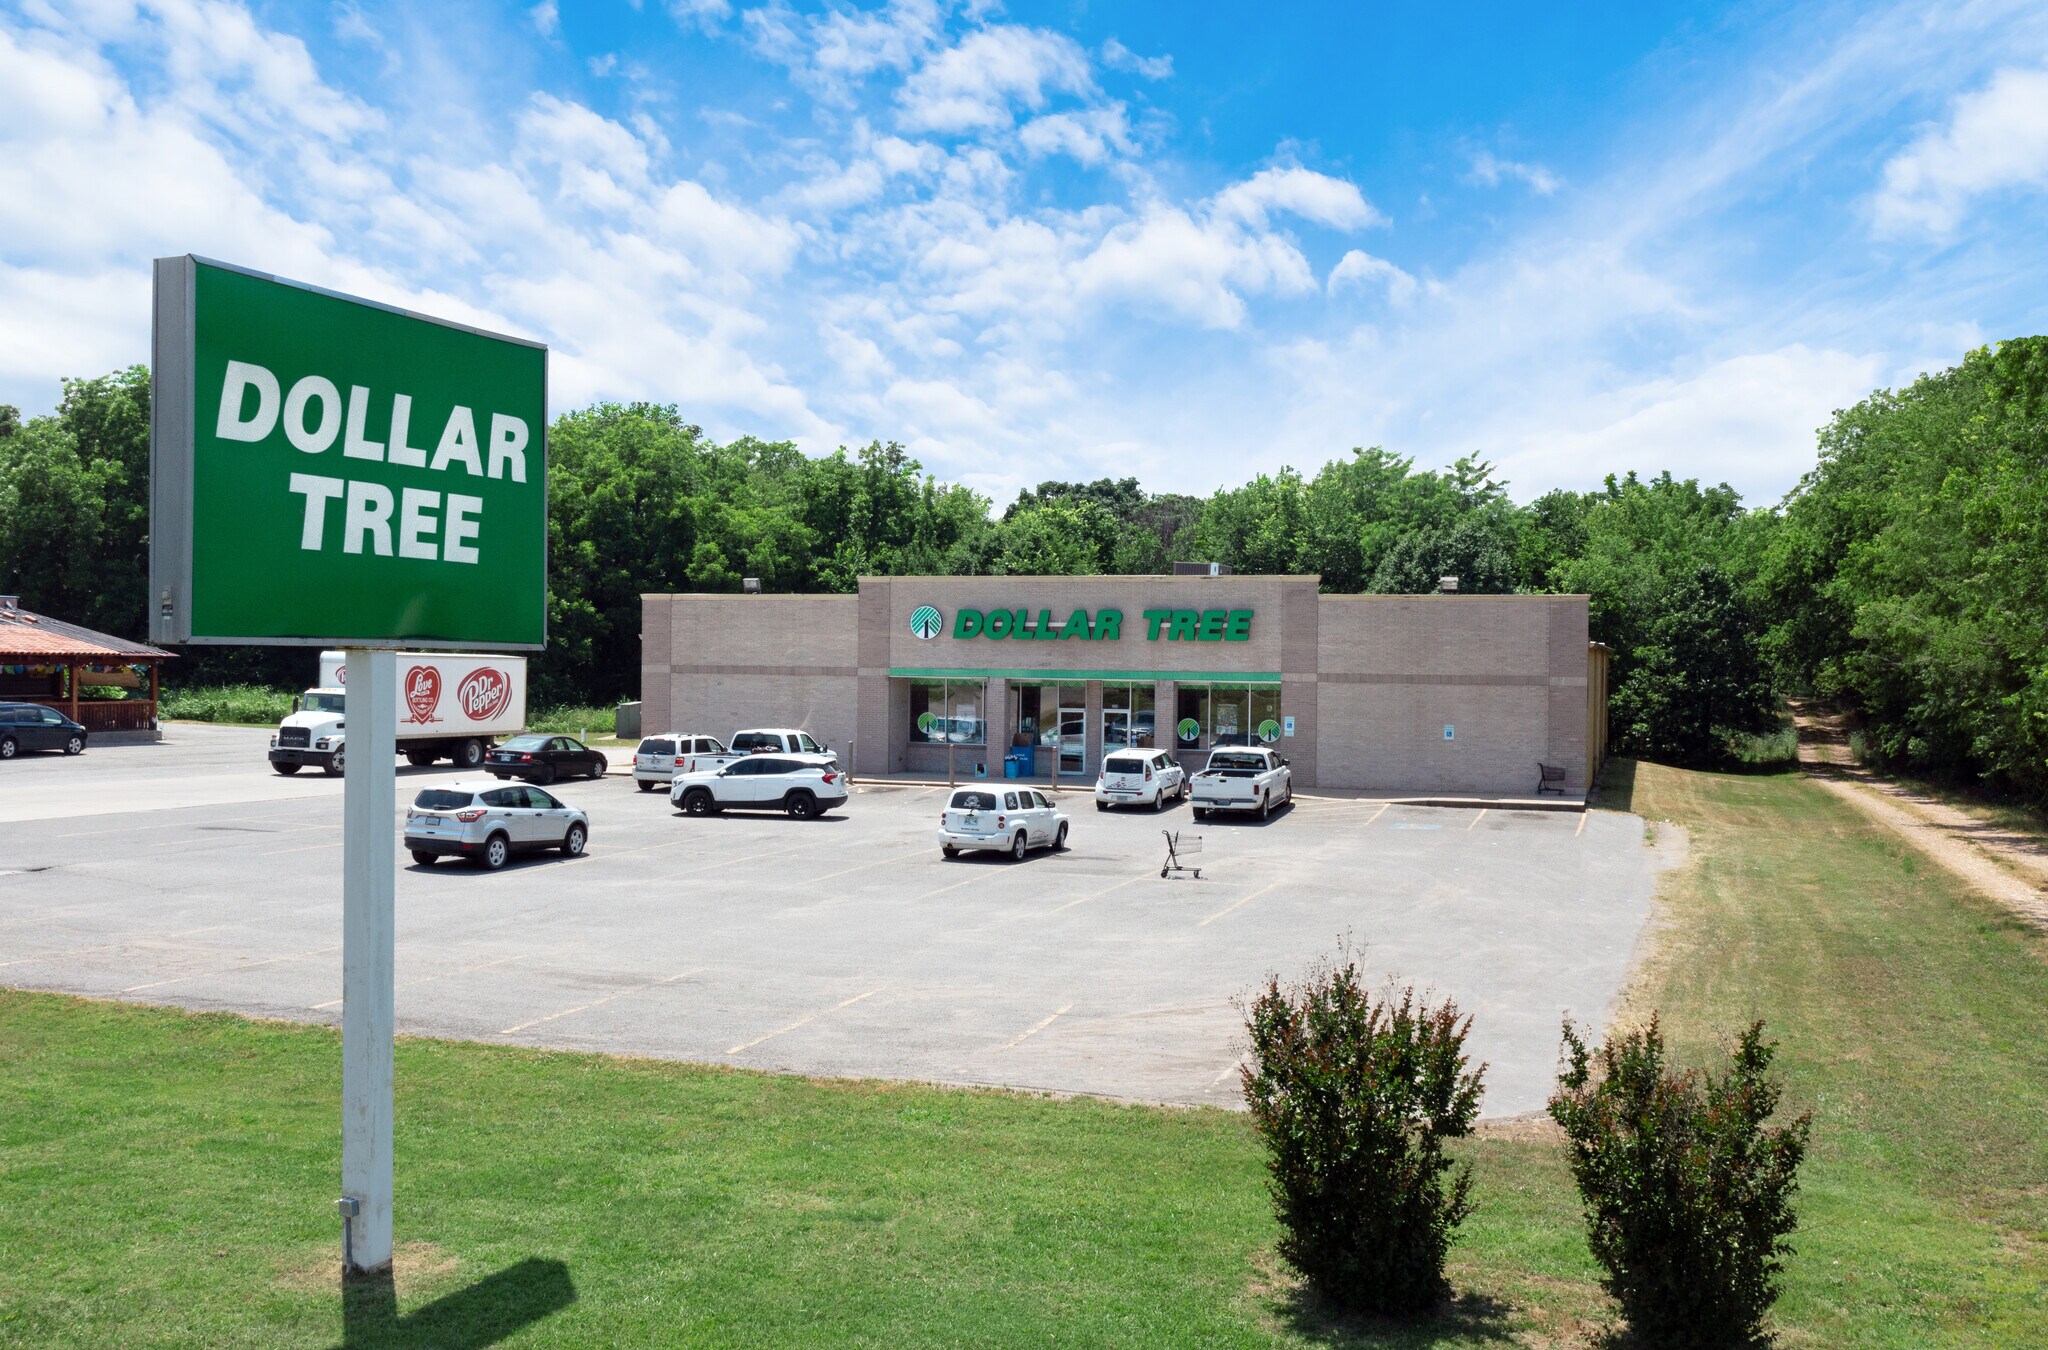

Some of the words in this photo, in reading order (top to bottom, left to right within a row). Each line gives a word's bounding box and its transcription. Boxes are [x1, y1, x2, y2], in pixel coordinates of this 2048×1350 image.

[216, 360, 529, 483] DOLLAR
[289, 472, 483, 564] TREE
[953, 609, 1123, 641] DOLLAR
[1143, 610, 1254, 642] TREE
[410, 674, 433, 698] Love
[468, 680, 502, 715] Pepper
[479, 675, 494, 696] Dr
